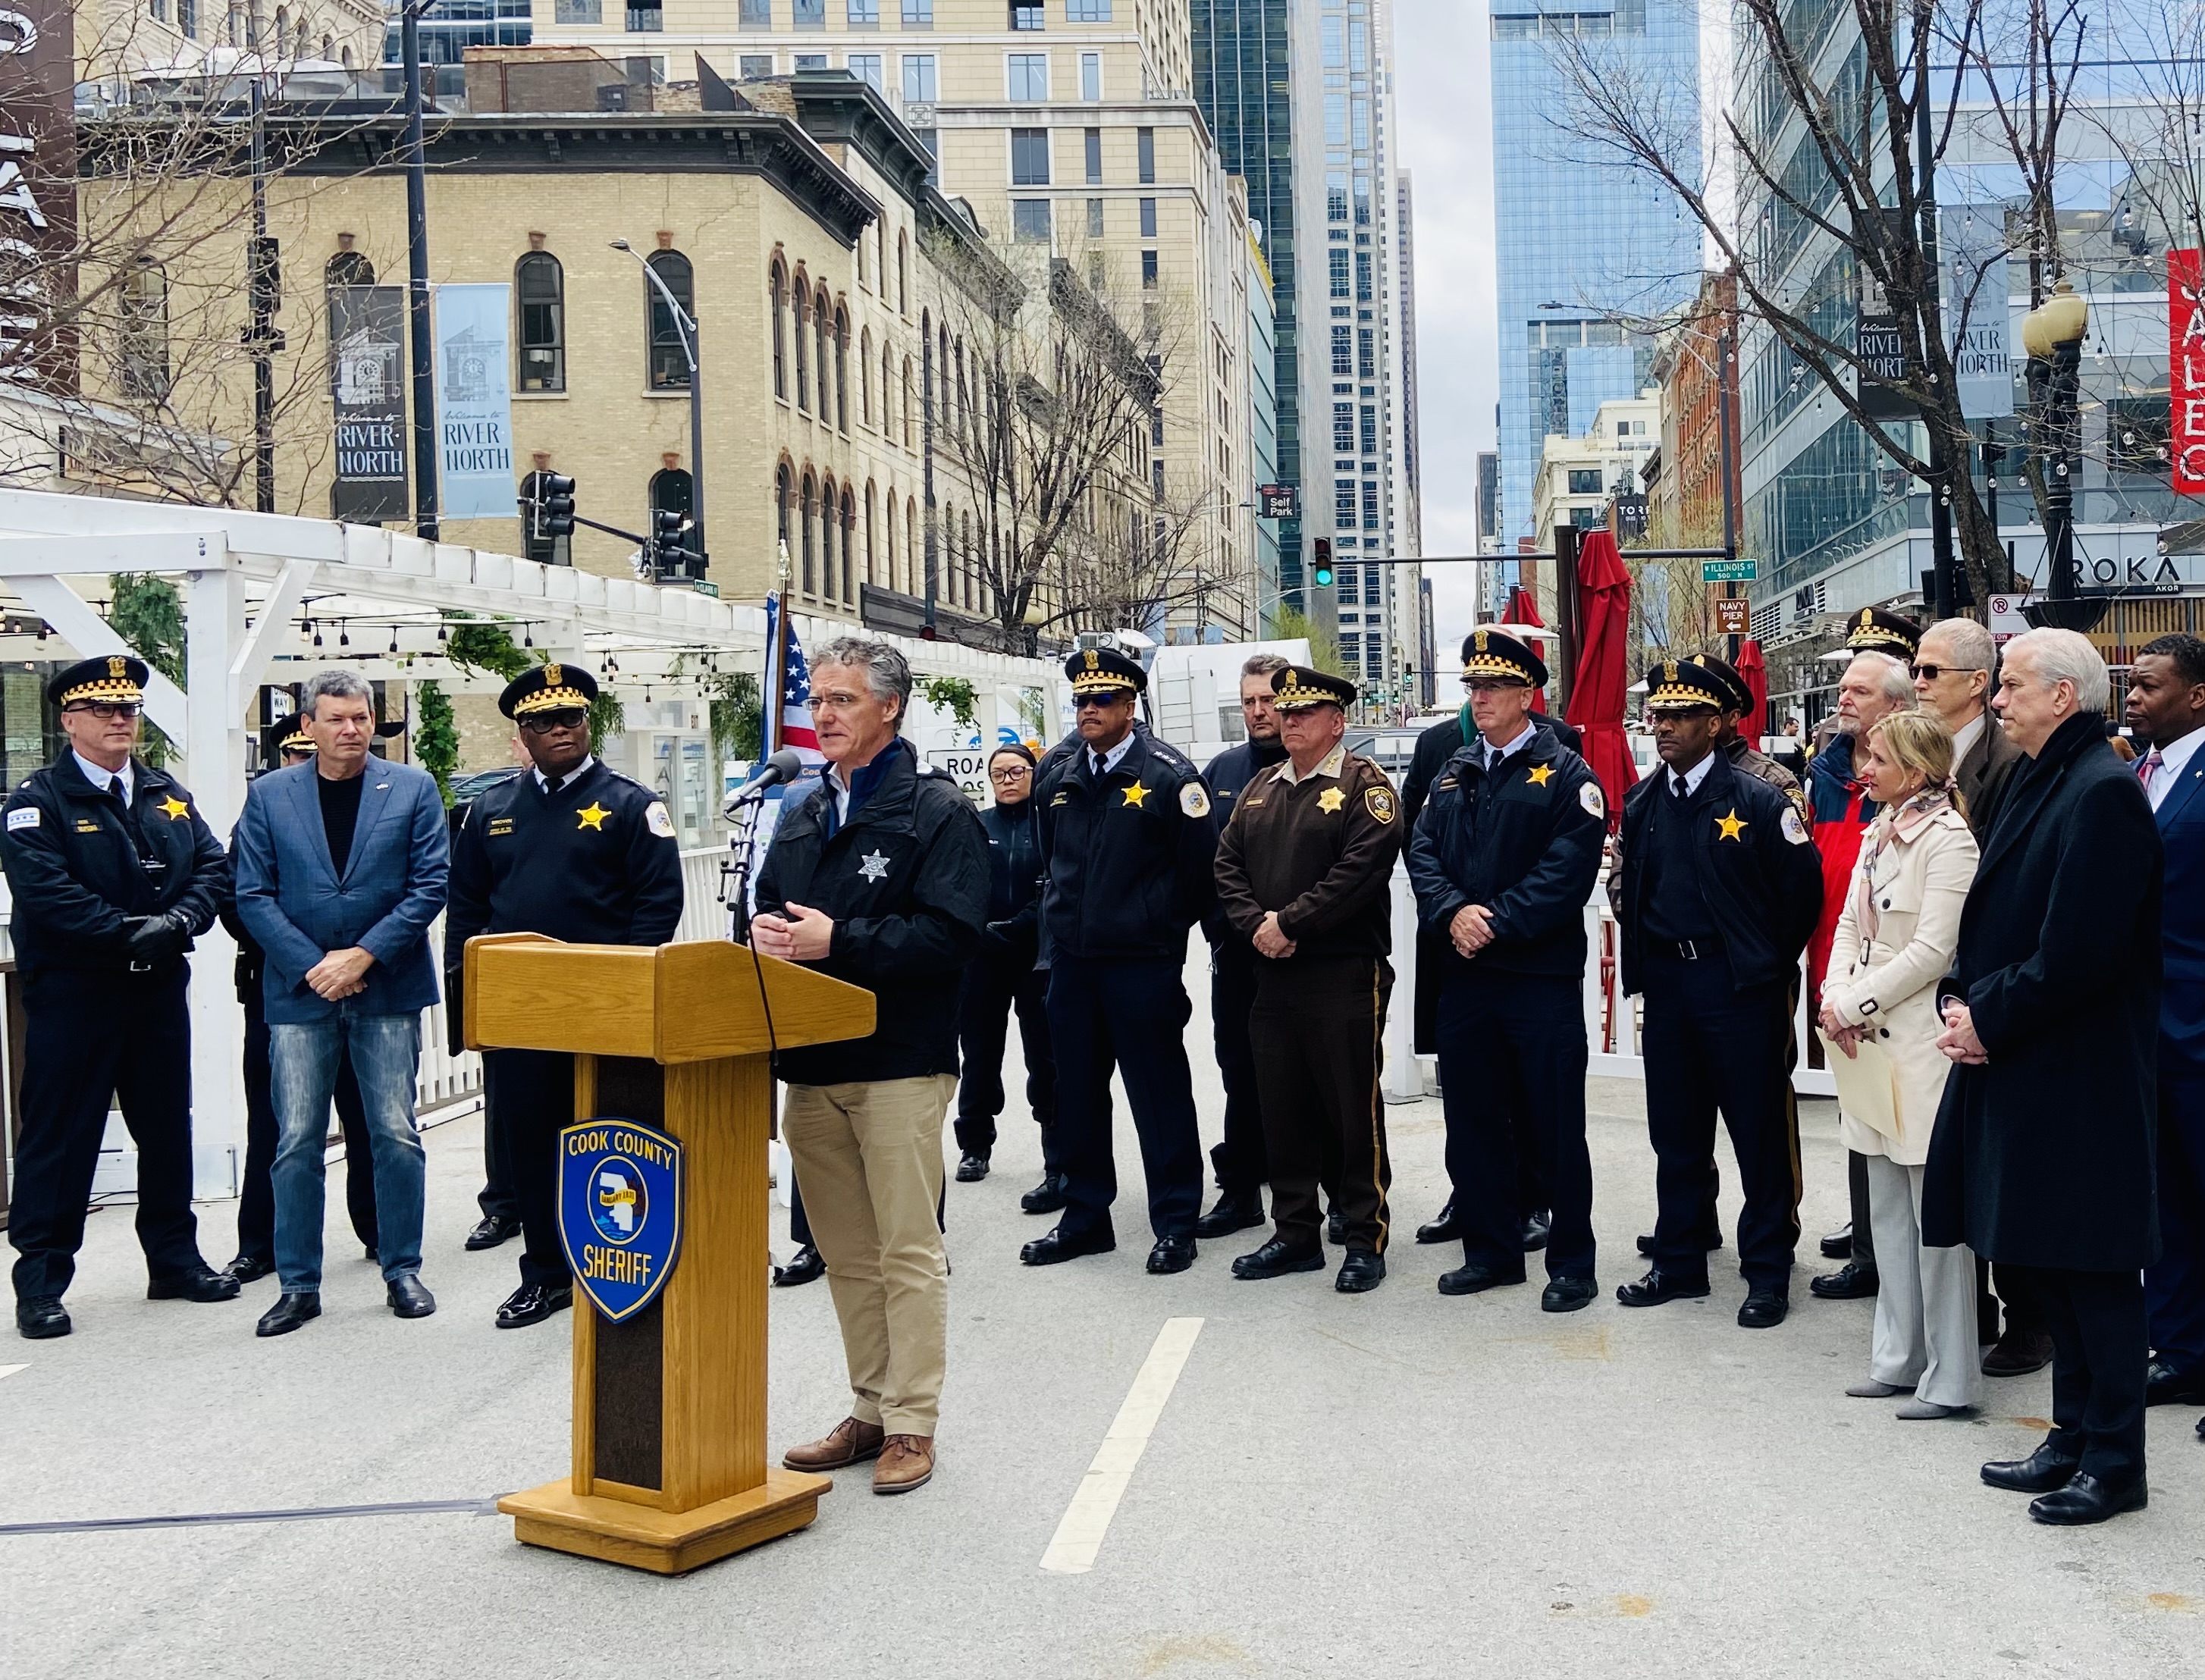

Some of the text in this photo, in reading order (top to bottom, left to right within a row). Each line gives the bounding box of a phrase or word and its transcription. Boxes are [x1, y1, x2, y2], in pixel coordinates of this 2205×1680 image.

[1861, 323, 1898, 332] Welcome
[1862, 357, 1905, 379] ORT
[336, 412, 402, 423] Welcome to
[444, 412, 486, 420] Welcome
[338, 425, 394, 447] RIVER
[444, 422, 500, 445] RIVER
[339, 450, 403, 474] NORTH
[447, 448, 510, 472] NORTH
[1270, 497, 1290, 506] Self
[1270, 507, 1293, 516] Park
[1711, 563, 1745, 572] ILLINOIS
[2072, 556, 2180, 585] ROKA
[1719, 601, 1745, 611] NAVY
[1722, 611, 1744, 620] PIER
[274, 697, 287, 708] WAY
[802, 767, 820, 776] Coo
[947, 757, 983, 775] ROA
[568, 1130, 673, 1171] COOK COUNTY
[583, 1243, 652, 1287] SHERIFF
